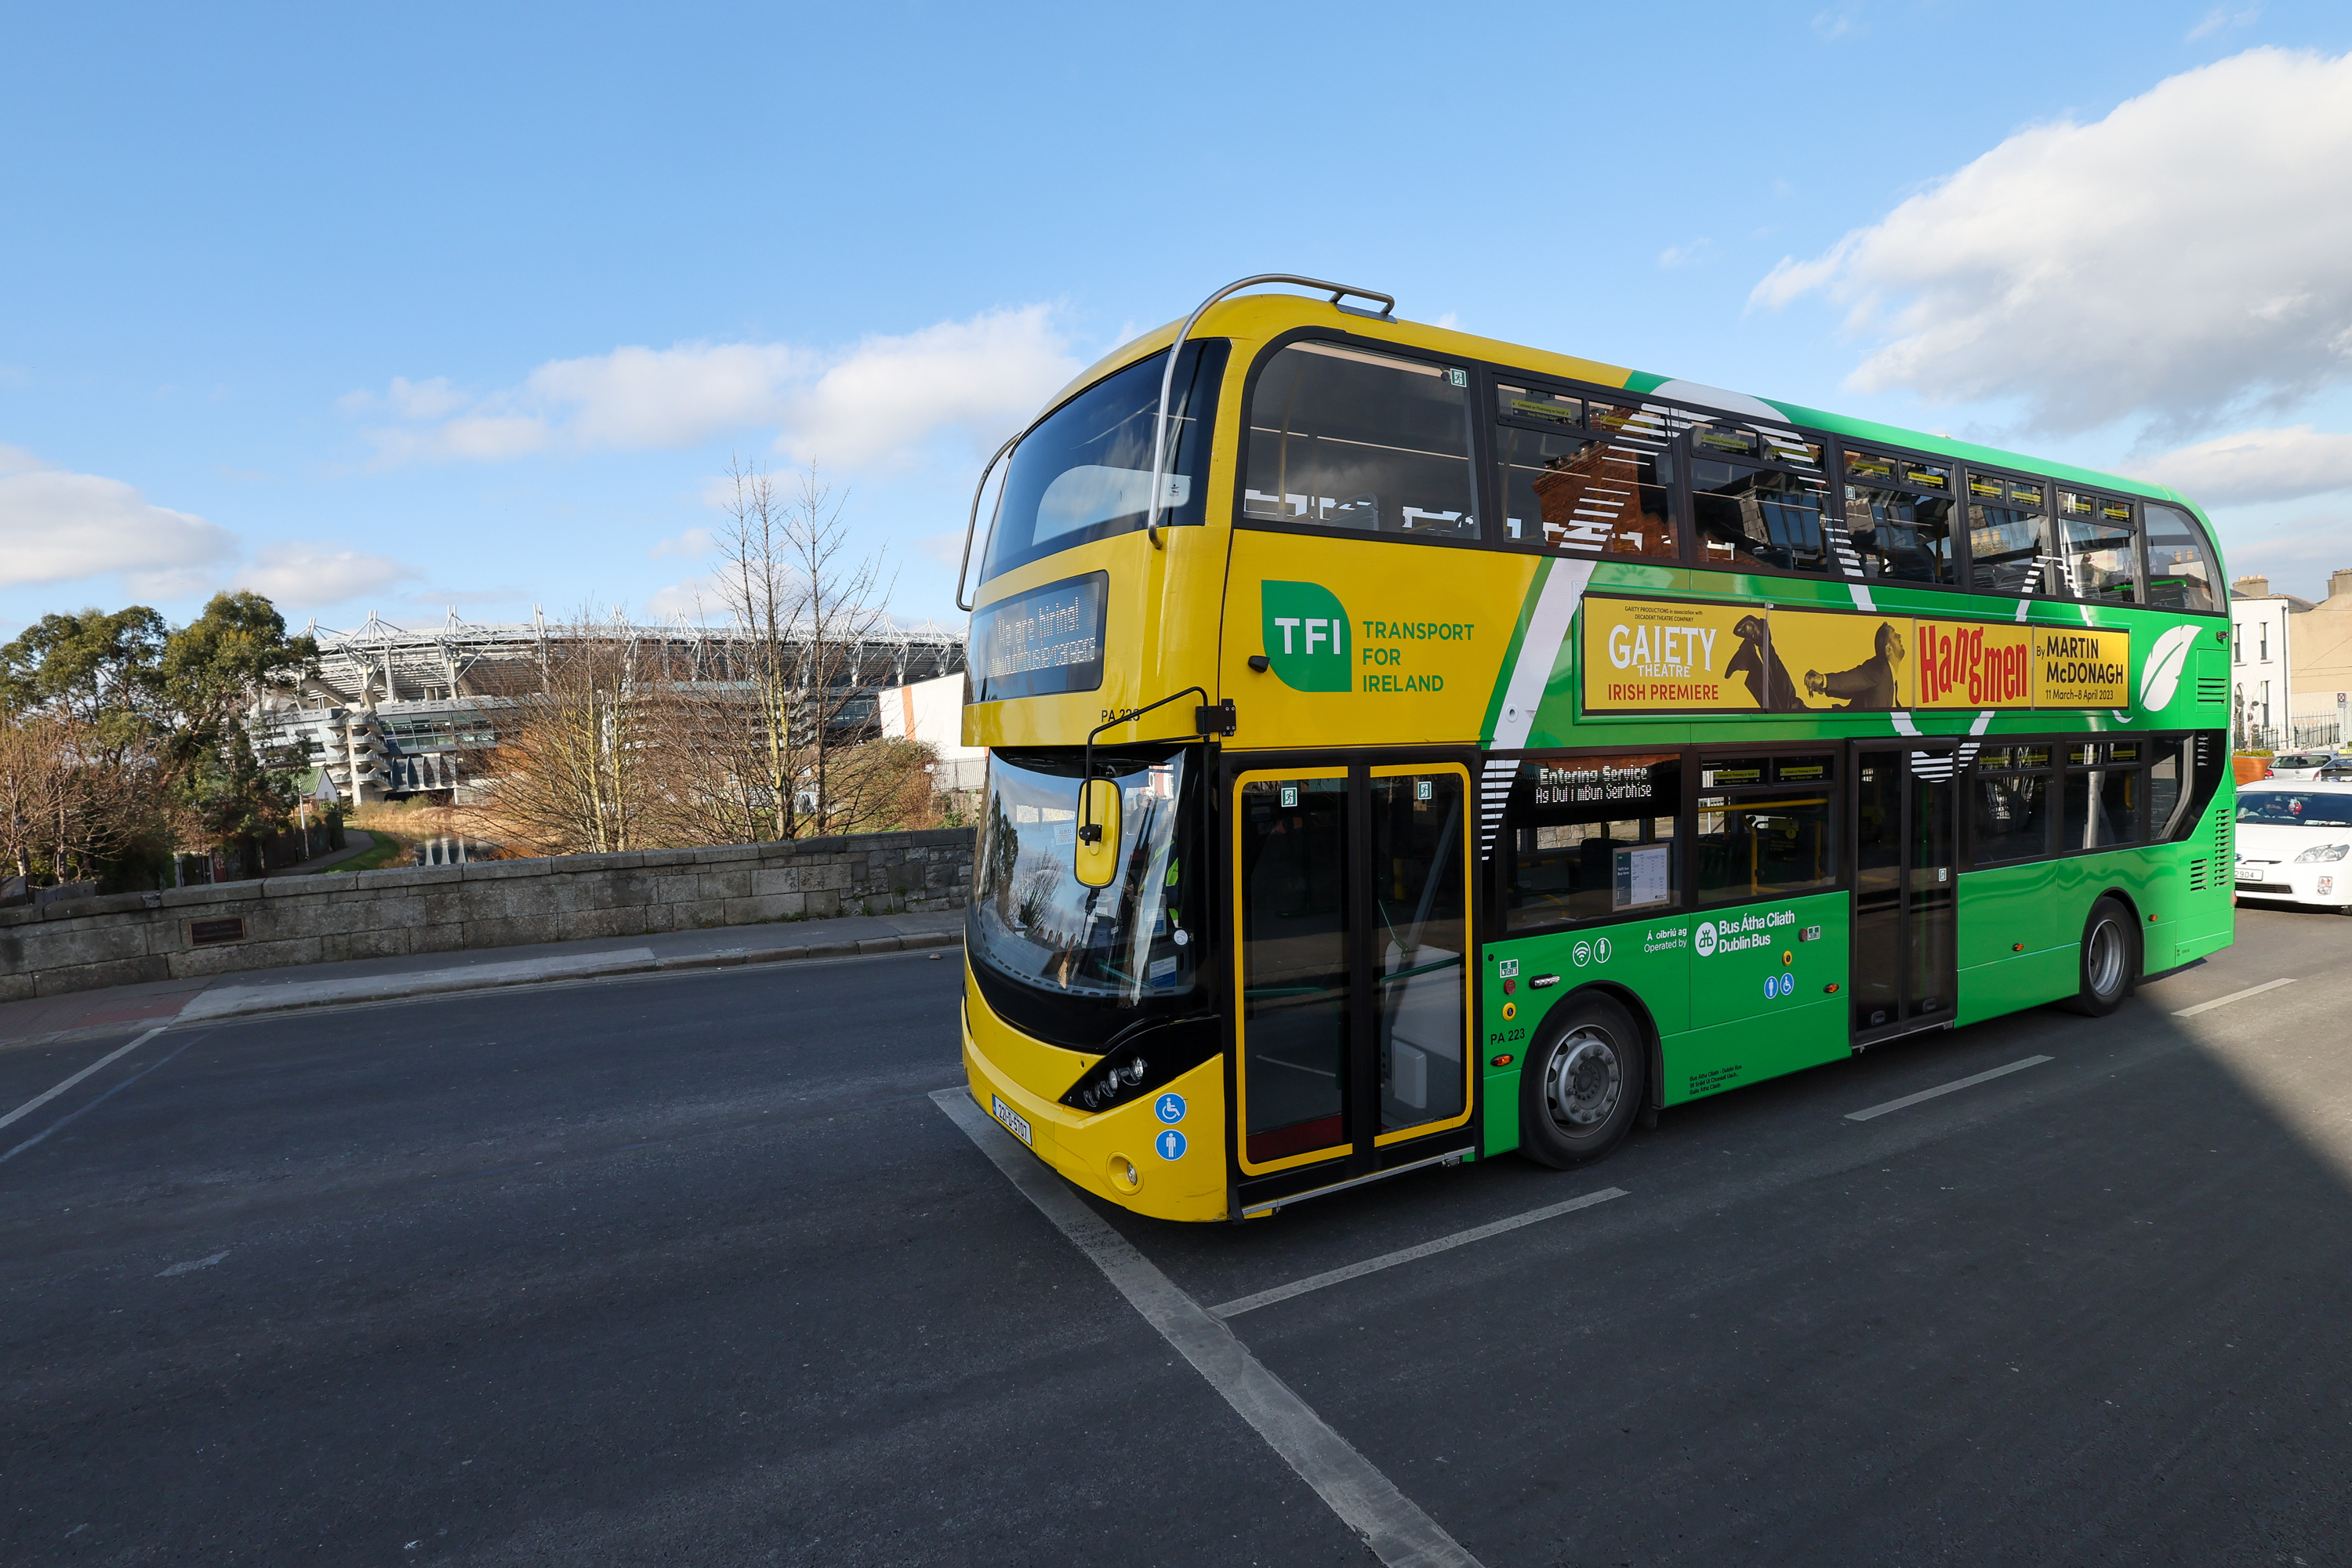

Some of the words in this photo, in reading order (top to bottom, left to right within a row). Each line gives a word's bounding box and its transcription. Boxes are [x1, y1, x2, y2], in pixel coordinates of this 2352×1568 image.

[997, 618, 1011, 648] We
[1015, 616, 1035, 644] are
[1038, 596, 1080, 637] hiring!
[1363, 620, 1475, 641] TRANSPORT
[1274, 617, 1341, 655] TFI
[1363, 648, 1401, 666] FOR
[1608, 624, 1717, 671] GAIETY
[2036, 645, 2045, 660] By
[2046, 635, 2099, 659] MARTIN
[1637, 663, 1691, 677] THEATRE
[1918, 625, 2027, 705] Hangmen
[2046, 661, 2123, 684] McDONAGH
[1363, 674, 1444, 692] IRELAND
[1608, 684, 1646, 701] IRISH
[1650, 684, 1719, 701] PREMIERE
[2045, 689, 2051, 699] 11
[2083, 689, 2098, 703] April
[2099, 690, 2114, 700] 2023
[1101, 709, 1116, 723] PA
[1540, 767, 1599, 785] Entering
[1602, 764, 1647, 782] Service
[1552, 785, 1568, 803] Dul
[1570, 785, 1574, 802] i
[1577, 784, 1603, 801] mBun
[1719, 920, 1740, 935] Bus
[1740, 913, 1765, 932] Átha
[1766, 909, 1795, 927] Cliath
[1646, 930, 1653, 941] Á
[1656, 927, 1677, 940] oibriú
[1678, 927, 1687, 938] ag
[1719, 935, 1751, 953] Dublin
[1751, 934, 1771, 948] Bus
[1643, 939, 1677, 953] Operated
[1679, 937, 1687, 948] by
[1490, 1032, 1505, 1045] PA
[1508, 1028, 1526, 1042] 223
